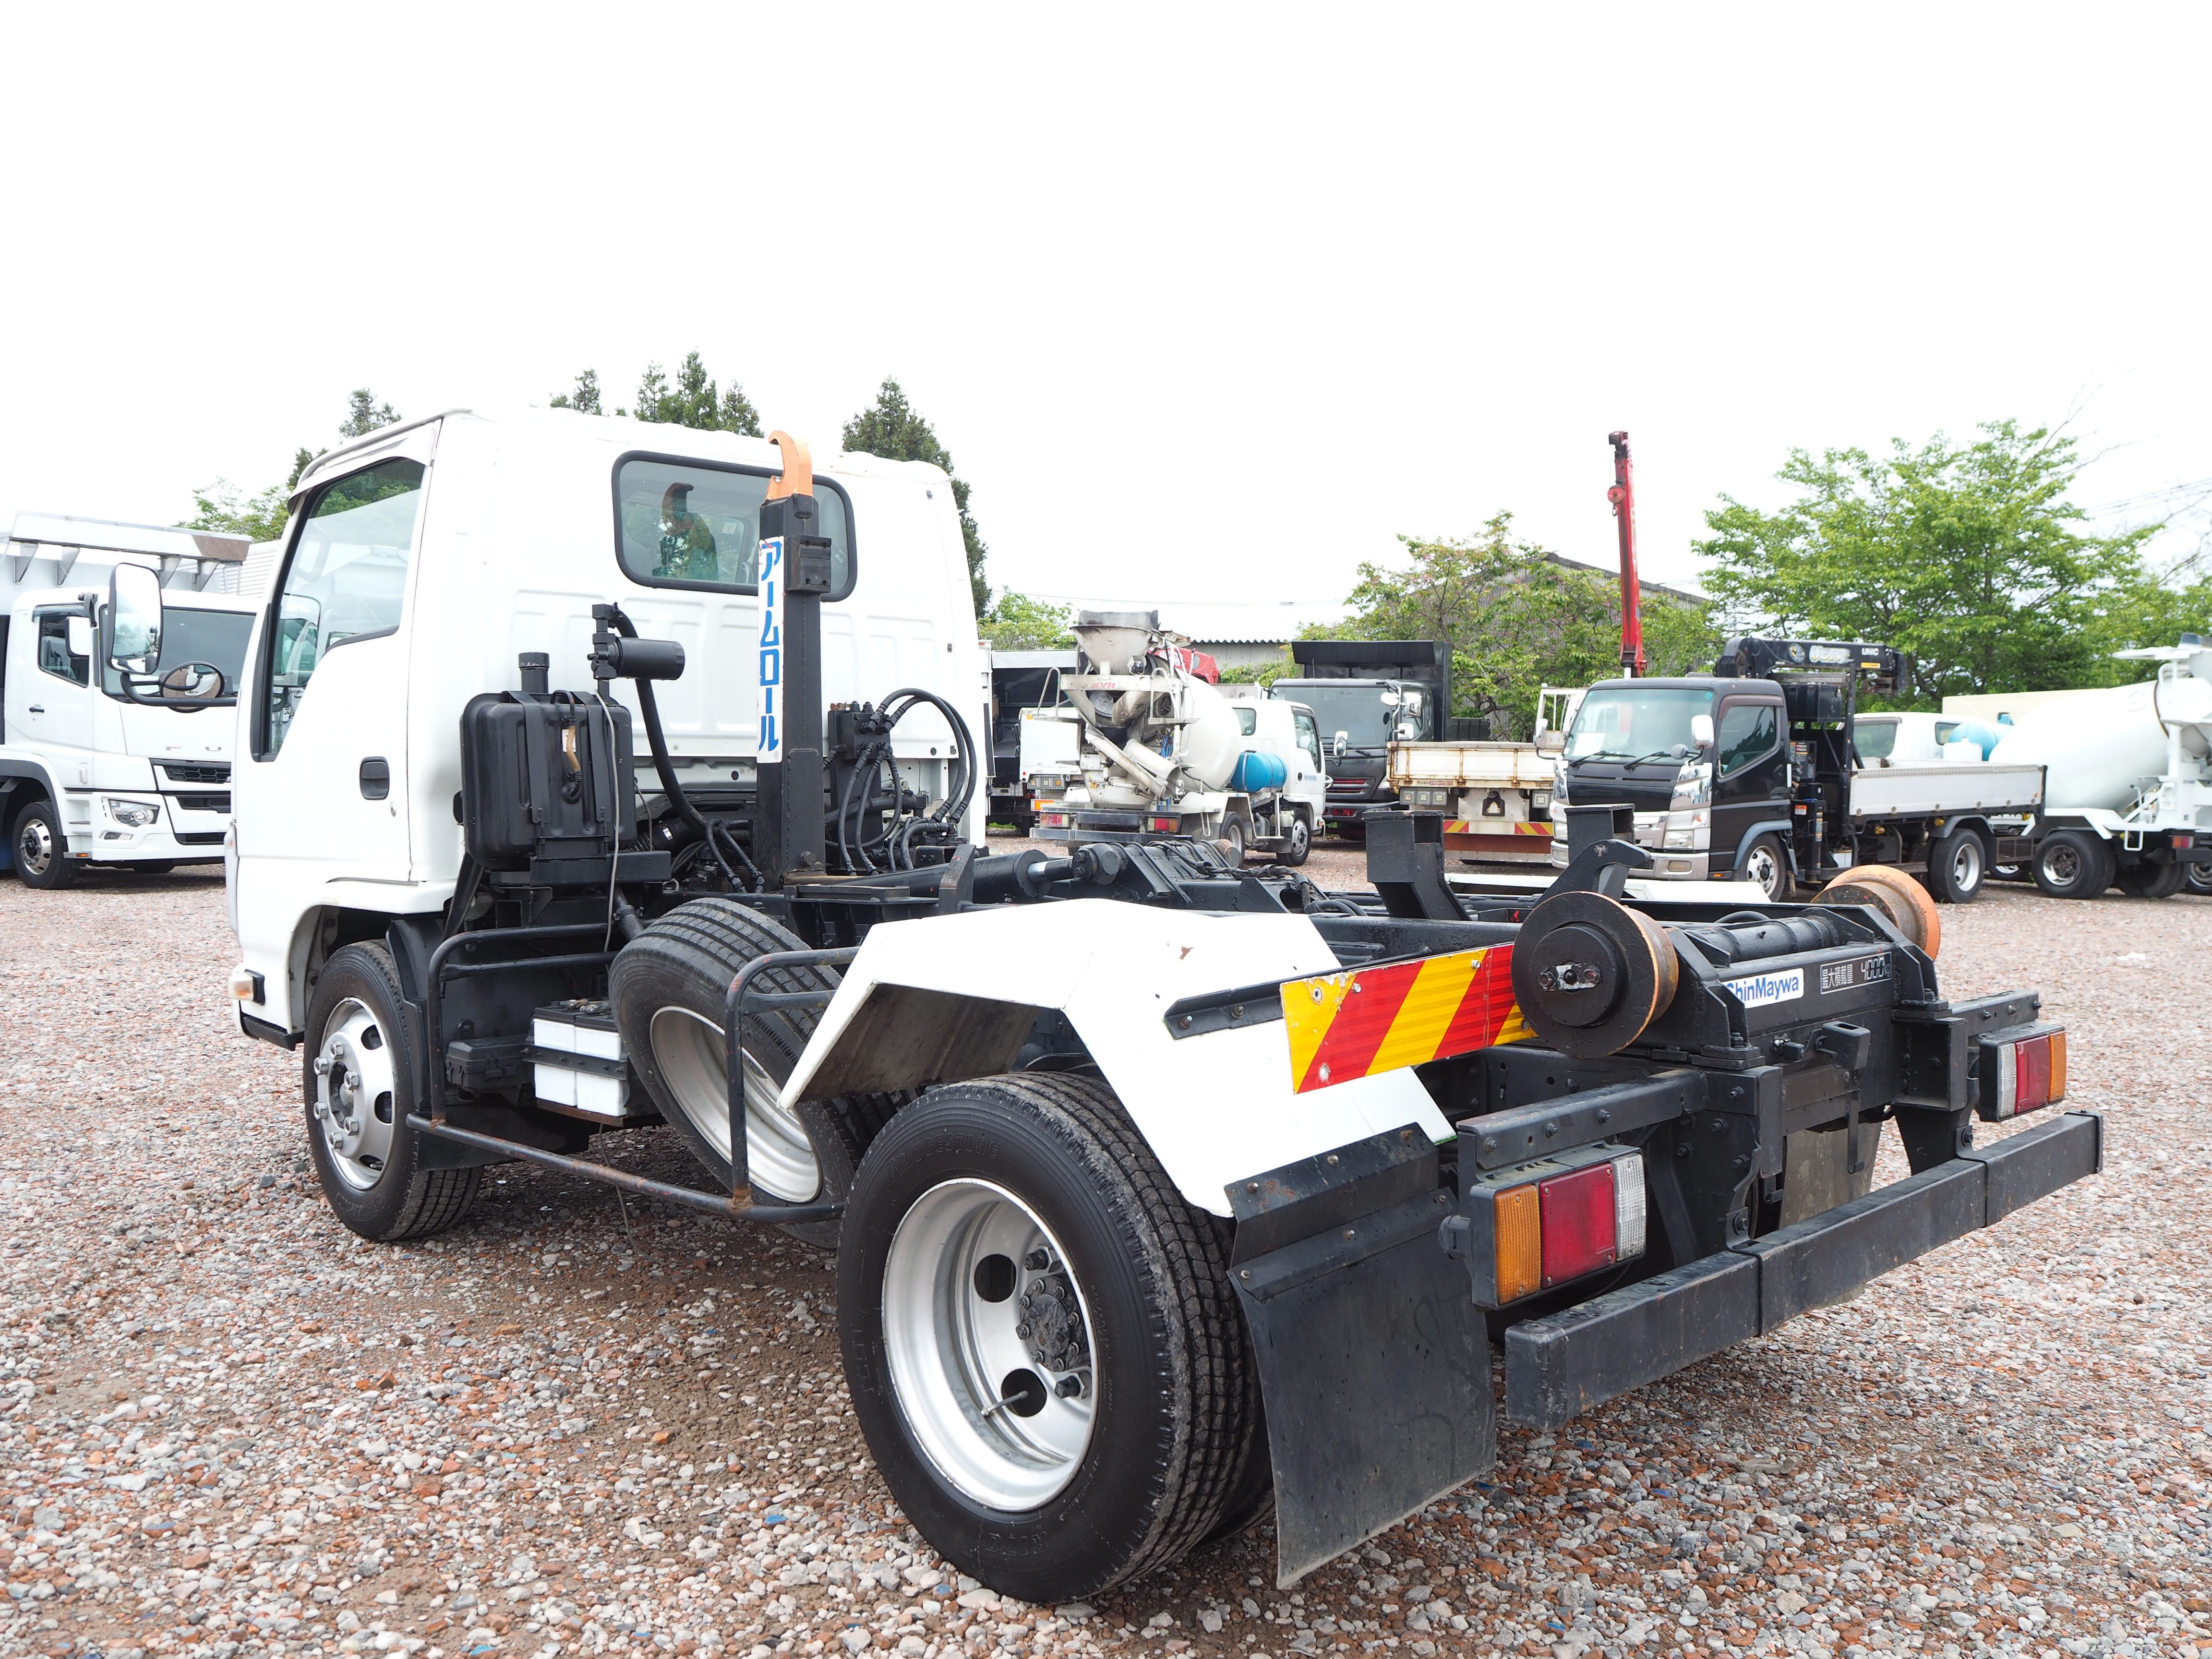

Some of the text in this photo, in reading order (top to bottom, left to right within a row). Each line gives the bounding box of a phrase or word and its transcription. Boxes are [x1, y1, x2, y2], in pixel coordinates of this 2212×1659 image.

[758, 541, 781, 752] アームロール
[1862, 648, 1879, 656] UNIC
[1822, 964, 1853, 989] 最大積載量
